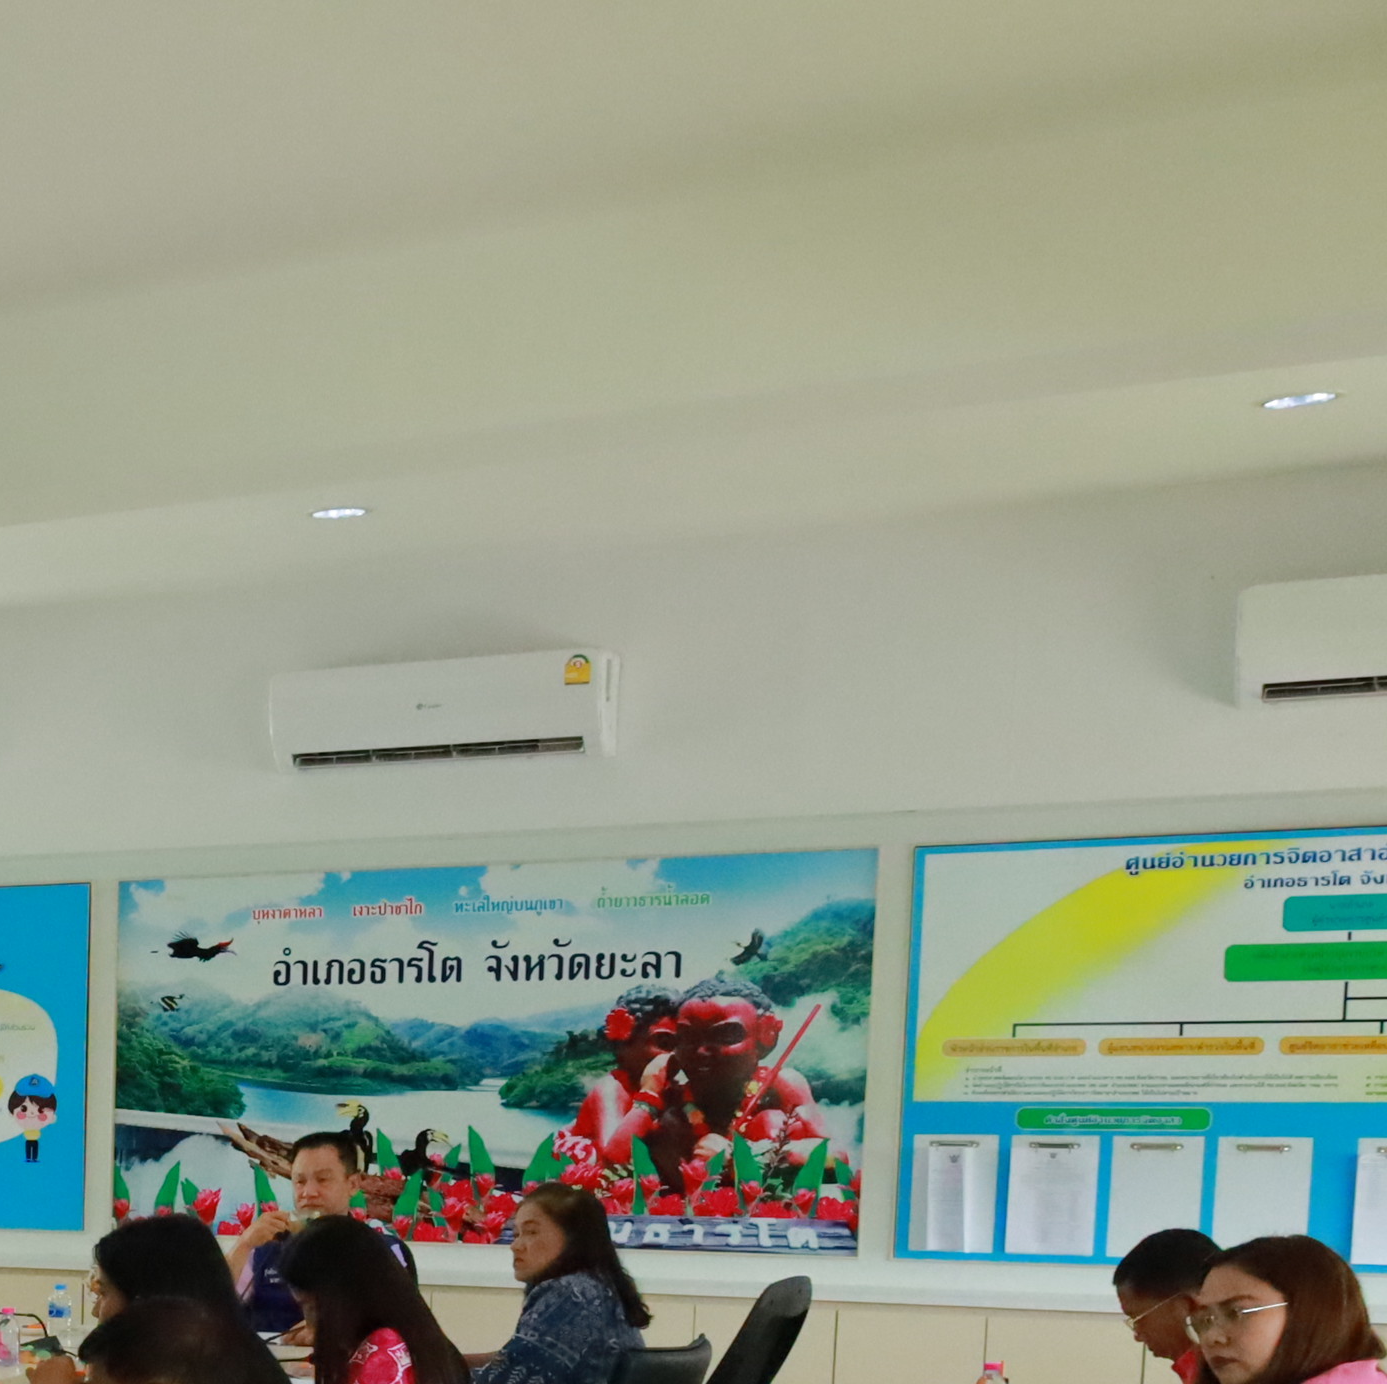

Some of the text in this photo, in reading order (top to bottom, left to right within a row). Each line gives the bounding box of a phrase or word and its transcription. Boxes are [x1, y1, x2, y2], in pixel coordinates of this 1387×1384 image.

[1243, 869, 1387, 889] อำเภอธารโต จัง
[252, 906, 323, 924] บุหงาดาหลา
[454, 895, 563, 917] ทะเลใหญ่บนภูเขา
[273, 937, 683, 986] อำเภอธารโต จังหวัดยะลา
